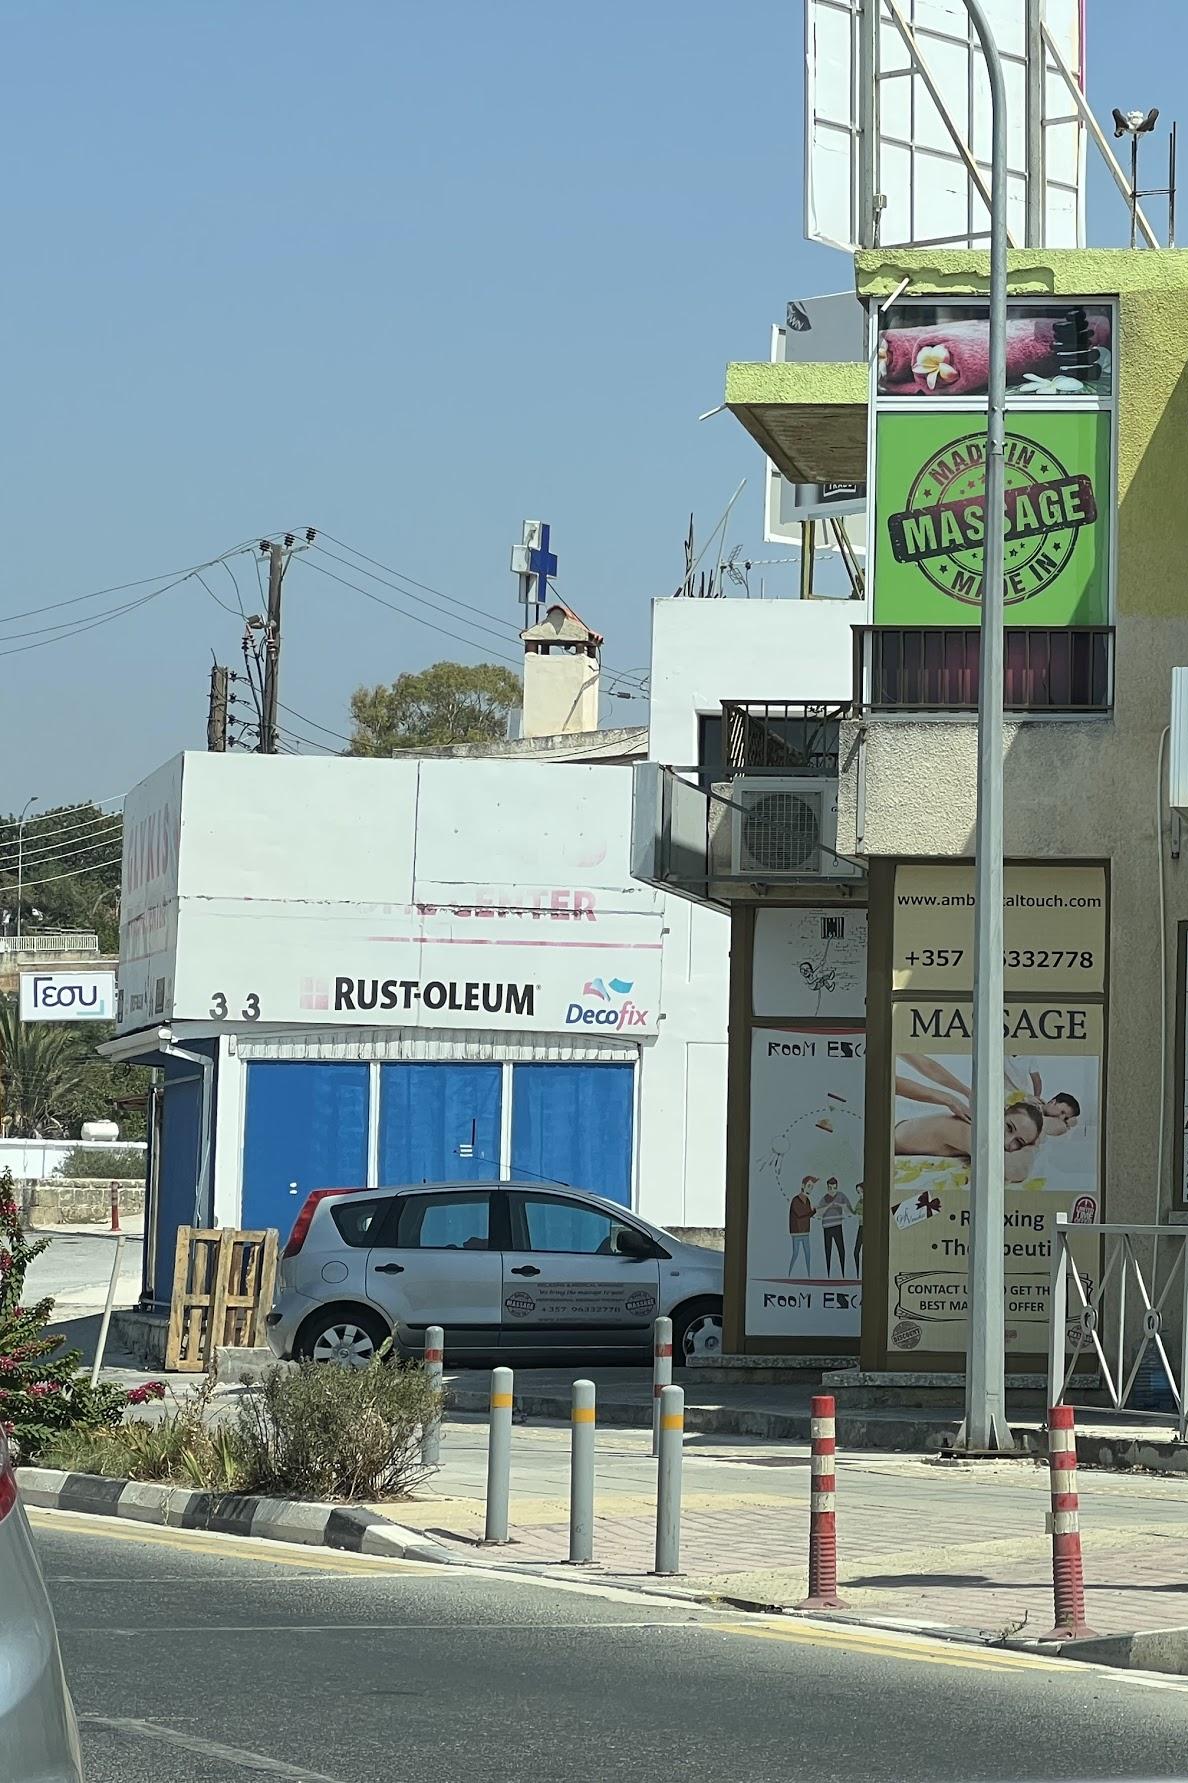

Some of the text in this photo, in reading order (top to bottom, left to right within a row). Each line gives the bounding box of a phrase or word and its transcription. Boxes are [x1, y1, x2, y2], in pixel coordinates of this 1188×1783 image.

[929, 443, 1036, 487] MAD IN
[1028, 551, 1058, 583] IN
[897, 893, 1101, 908] www.ambaltouch.com
[905, 950, 1094, 969] +357 332778
[565, 1001, 649, 1031] Decofix
[909, 1008, 1087, 1040] MAAGE
[827, 1040, 866, 1058] ESC
[960, 1210, 1045, 1231] Rxing
[907, 1285, 960, 1295] CONTACT
[1010, 1286, 1032, 1295] GET
[1036, 1286, 1051, 1296] TH
[823, 1292, 862, 1309] ESC
[919, 1301, 946, 1311] BEST
[1009, 1302, 1044, 1312] OFFER
